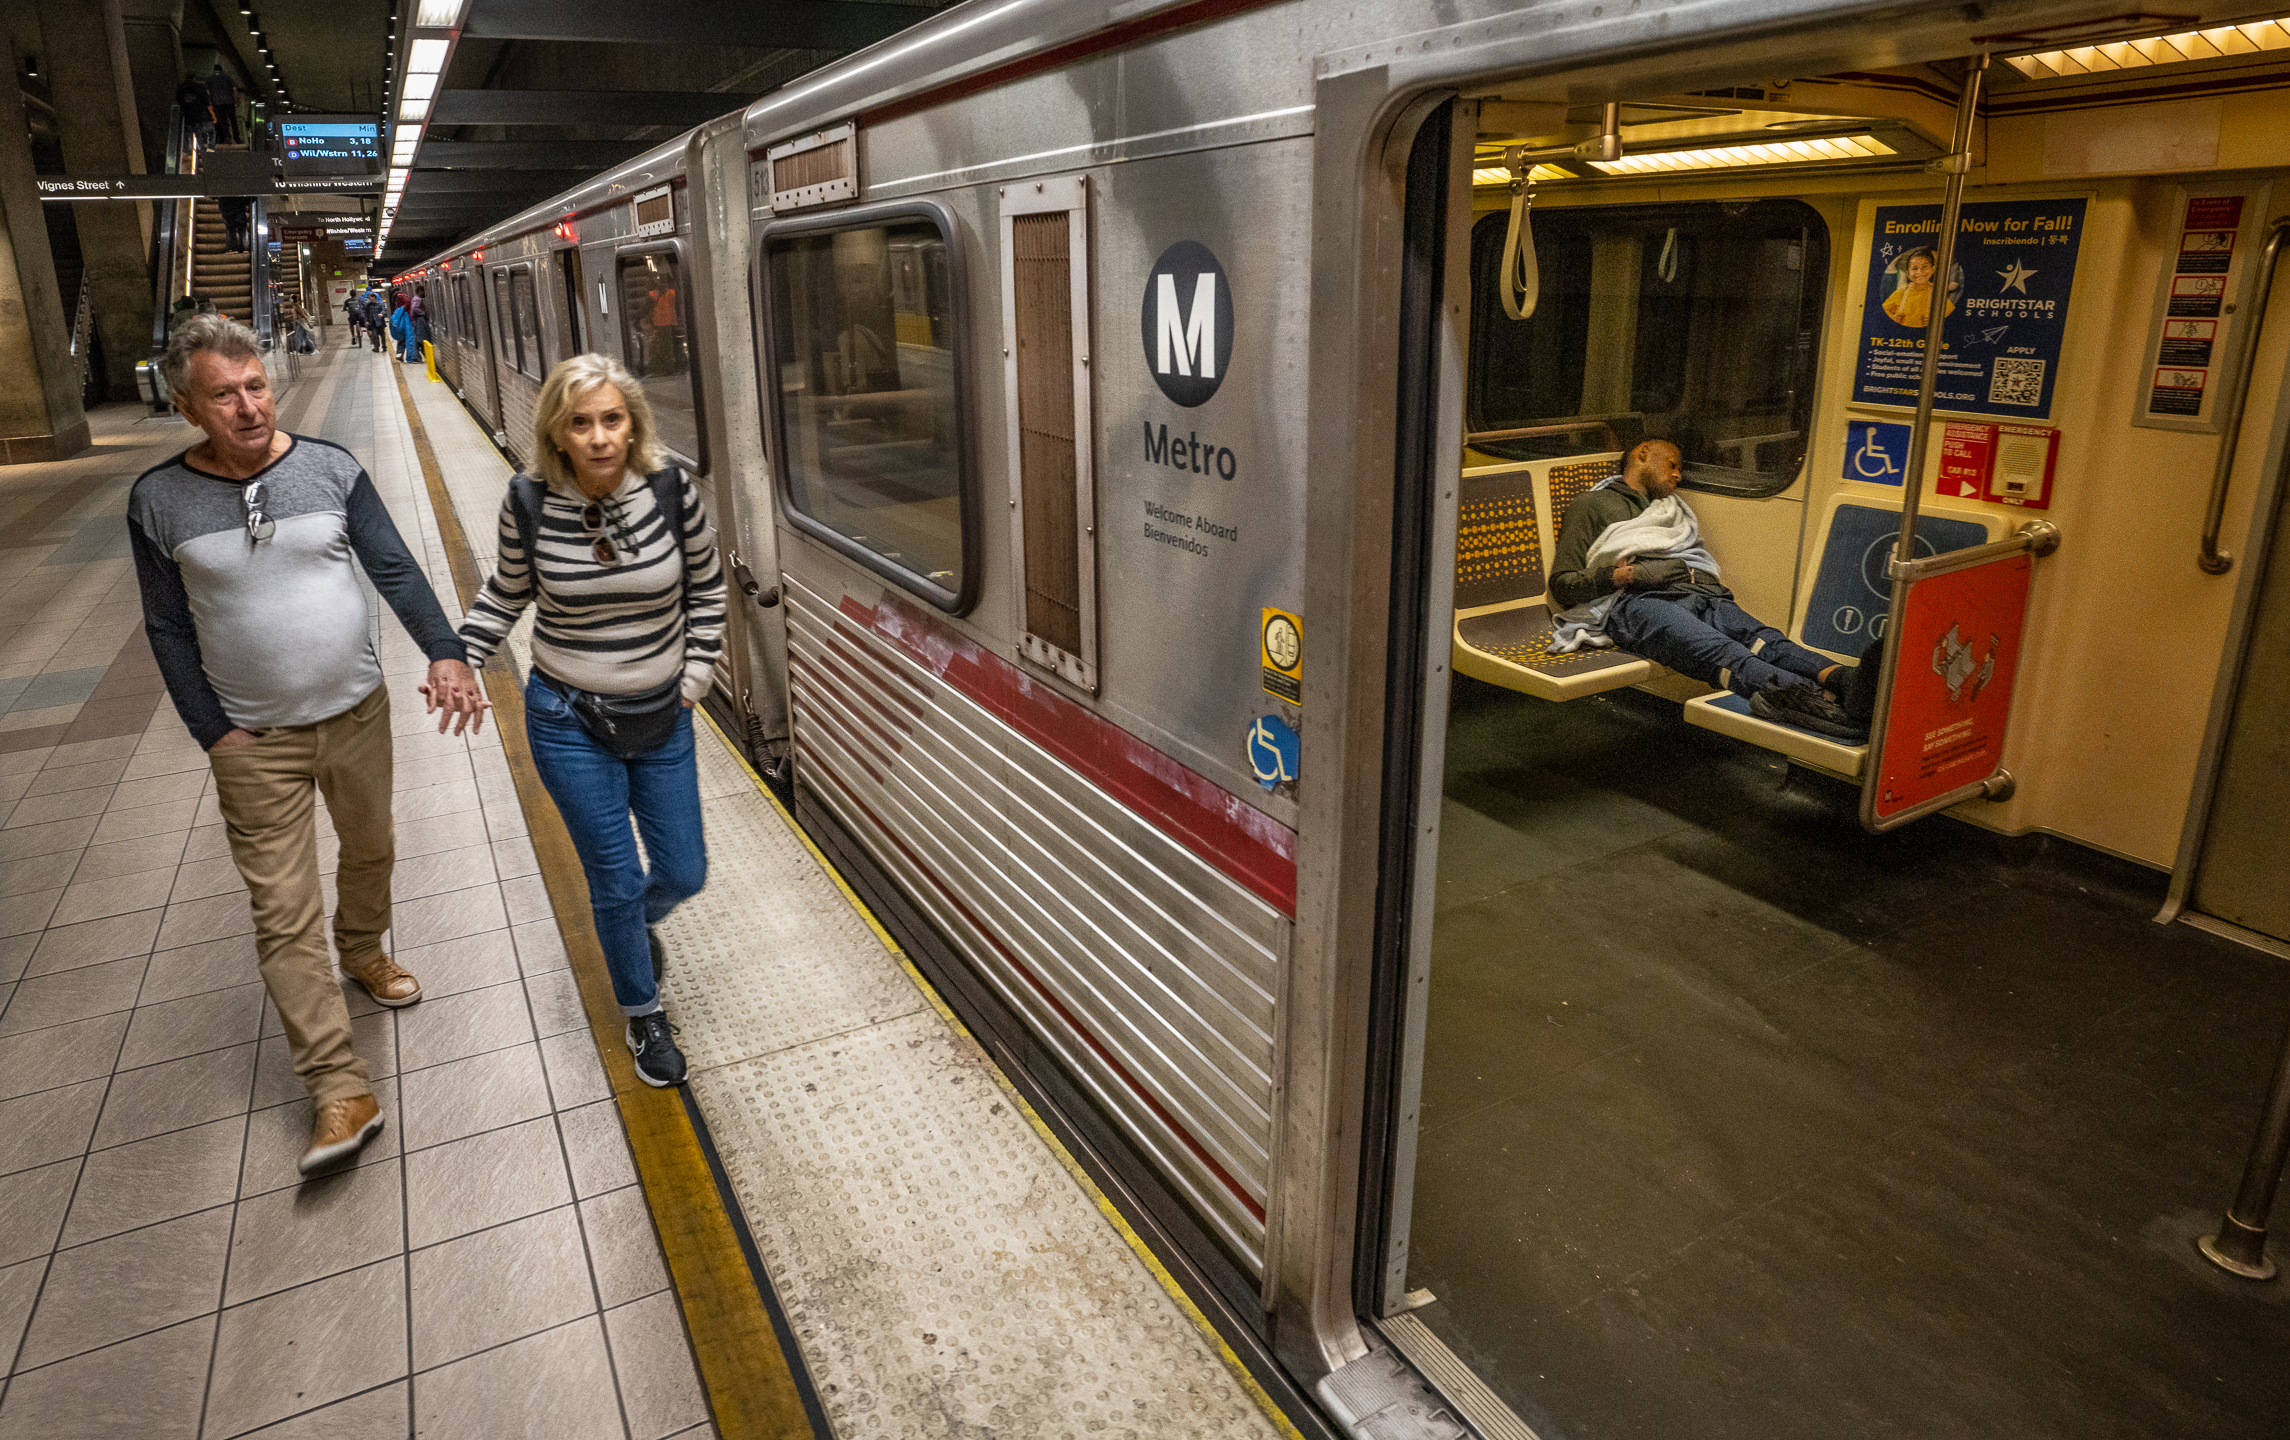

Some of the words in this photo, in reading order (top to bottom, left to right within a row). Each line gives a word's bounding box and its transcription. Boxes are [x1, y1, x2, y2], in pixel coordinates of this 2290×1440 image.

[299, 137, 325, 145] NoHo
[300, 150, 348, 158] Wil/Wstrn
[351, 150, 365, 158] 11,
[37, 181, 75, 192] Vignes
[76, 180, 110, 190] Street
[1885, 220, 1941, 234] Enrolli
[1961, 218, 1999, 233] Now
[2004, 217, 2030, 232] for
[2033, 215, 2073, 231] Fall!
[1983, 237, 2039, 246] Inscribiendo
[1966, 298, 2055, 311] BRIGHTSTAR
[1965, 309, 2054, 319] SCHOOLS
[1157, 272, 1216, 379] M
[2006, 346, 2036, 355] APPLY
[1863, 385, 1976, 401] BRIGHTSTARSOLS.ORG
[1999, 425, 2053, 437] EMERGENCY
[1944, 440, 1965, 449] PUSH
[1143, 420, 1237, 482] Metro
[1943, 448, 1953, 456] TO
[1953, 449, 1972, 458] CALL
[1144, 500, 1193, 529] Welcome
[1195, 515, 1238, 542] Aboard
[1144, 522, 1209, 557] Bienvenidos
